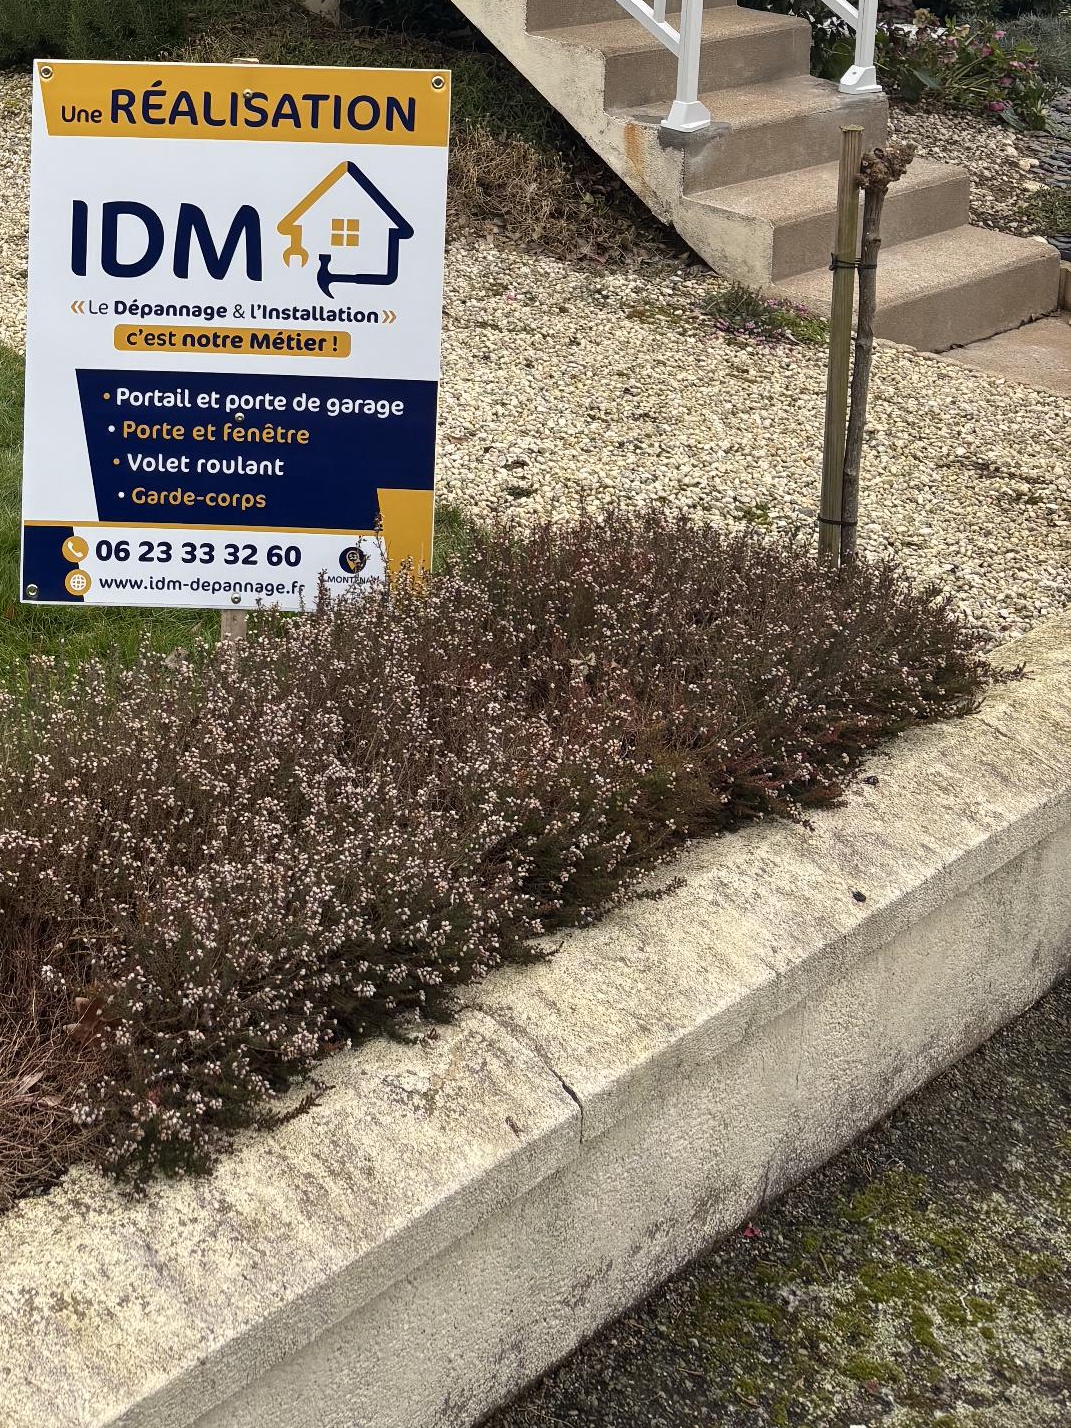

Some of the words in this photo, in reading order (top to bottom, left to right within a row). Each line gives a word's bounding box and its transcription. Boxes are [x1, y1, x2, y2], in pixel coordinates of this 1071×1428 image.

[61, 105, 103, 124] Une
[110, 79, 417, 133] RÉALISATION
[70, 199, 263, 282] IDM
[113, 298, 228, 322] Dépannage
[232, 303, 246, 320] &
[126, 328, 177, 347] c'est
[181, 332, 243, 349] notre
[249, 331, 326, 352] Métier
[332, 335, 338, 353] !
[116, 387, 192, 408] Portail
[196, 390, 221, 409] et
[225, 392, 287, 415] porte
[292, 392, 321, 413] de
[326, 397, 405, 419] garage
[122, 420, 185, 442] Porte
[192, 423, 217, 442] et
[222, 422, 310, 445] fenêtre
[126, 452, 191, 473] Volet
[196, 455, 285, 476] roulant
[131, 486, 267, 511] Garde-corps
[95, 539, 131, 563] 06
[137, 540, 173, 564] 23
[180, 541, 216, 565] 33
[223, 543, 259, 566] 32
[266, 544, 302, 568] 60
[98, 575, 305, 596] www.idm-depannage.fr
